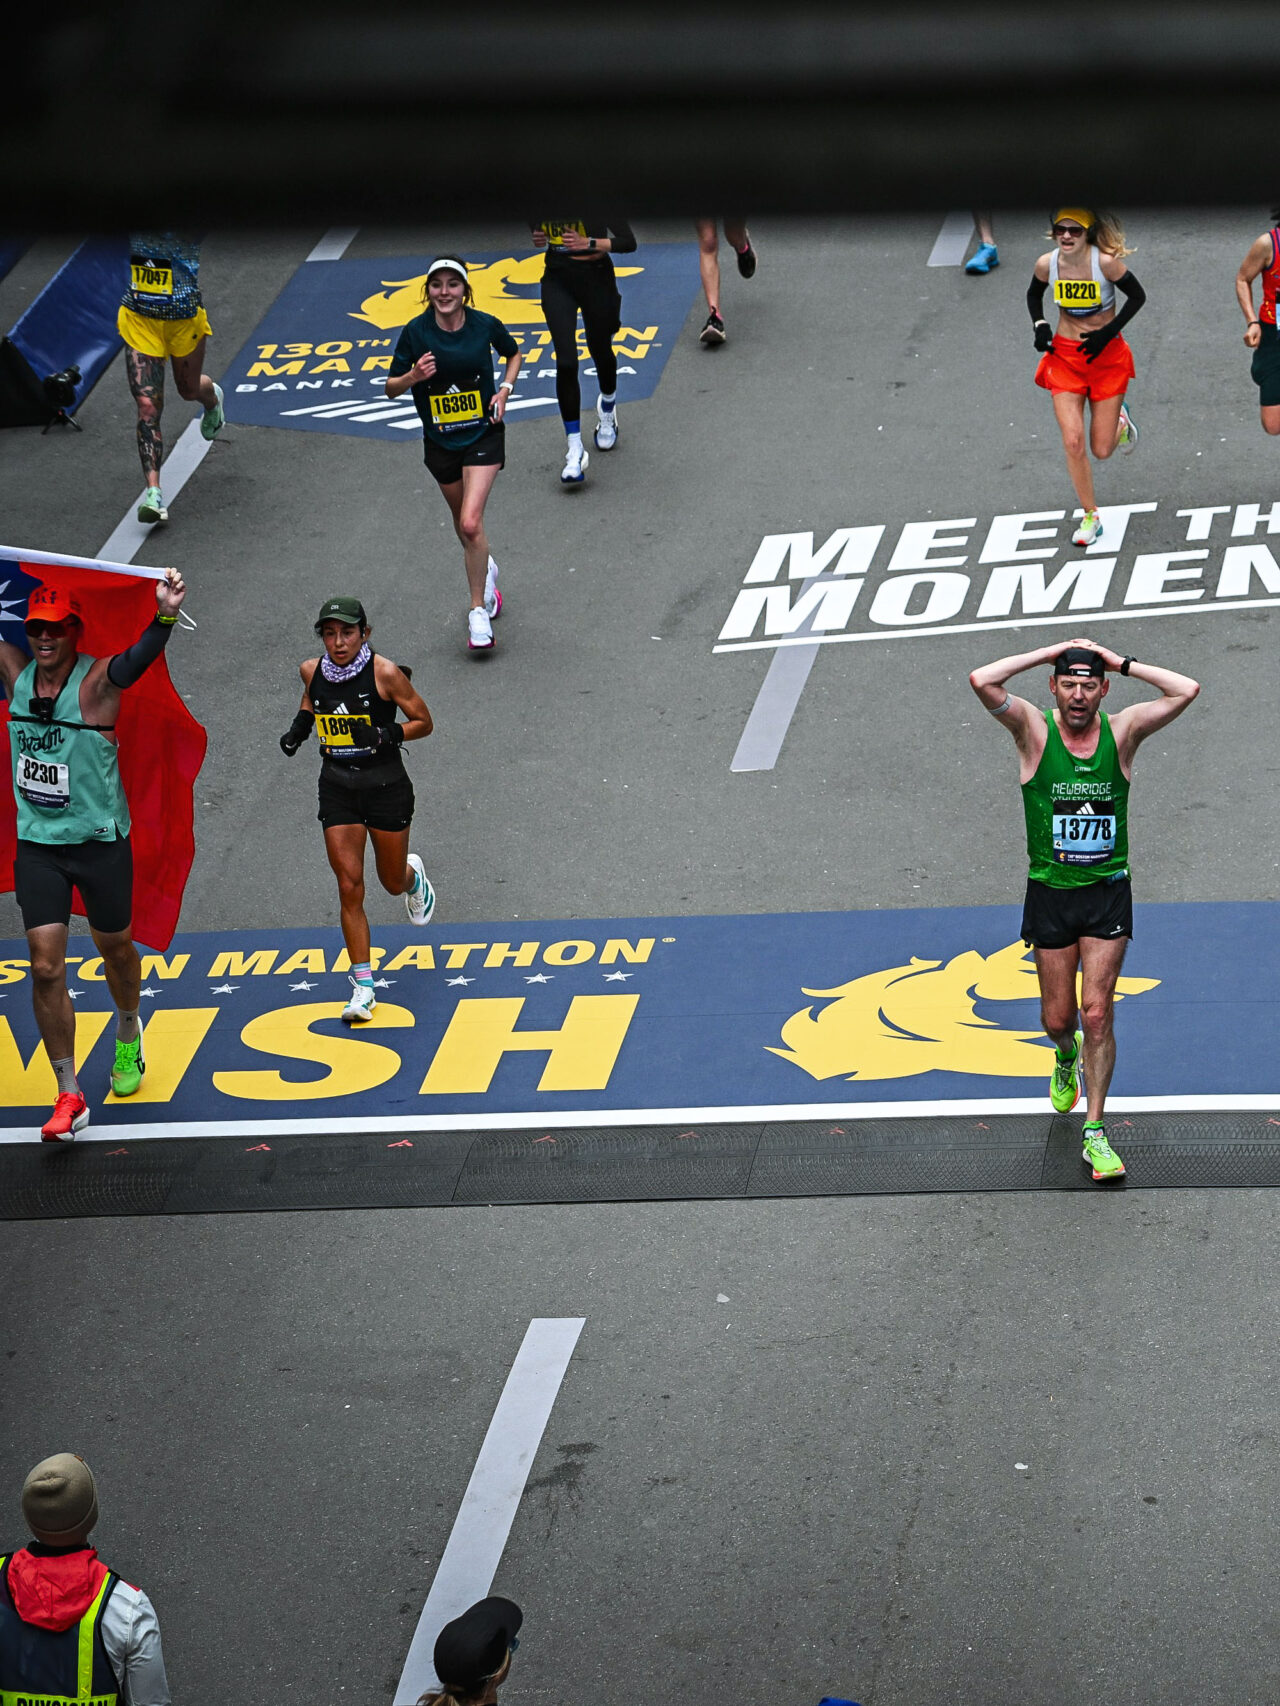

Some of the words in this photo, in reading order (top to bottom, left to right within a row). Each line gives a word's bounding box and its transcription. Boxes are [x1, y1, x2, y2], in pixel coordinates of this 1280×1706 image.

[135, 267, 169, 286] 17047
[1058, 282, 1097, 299] 18220
[257, 338, 392, 359] 130TH
[235, 378, 356, 393] BANK
[434, 393, 478, 415] 16380
[743, 502, 1158, 584] MEET
[23, 758, 59, 786] 8230
[1052, 782, 1112, 795] NEWBRIDGE
[1059, 818, 1112, 841] 13778
